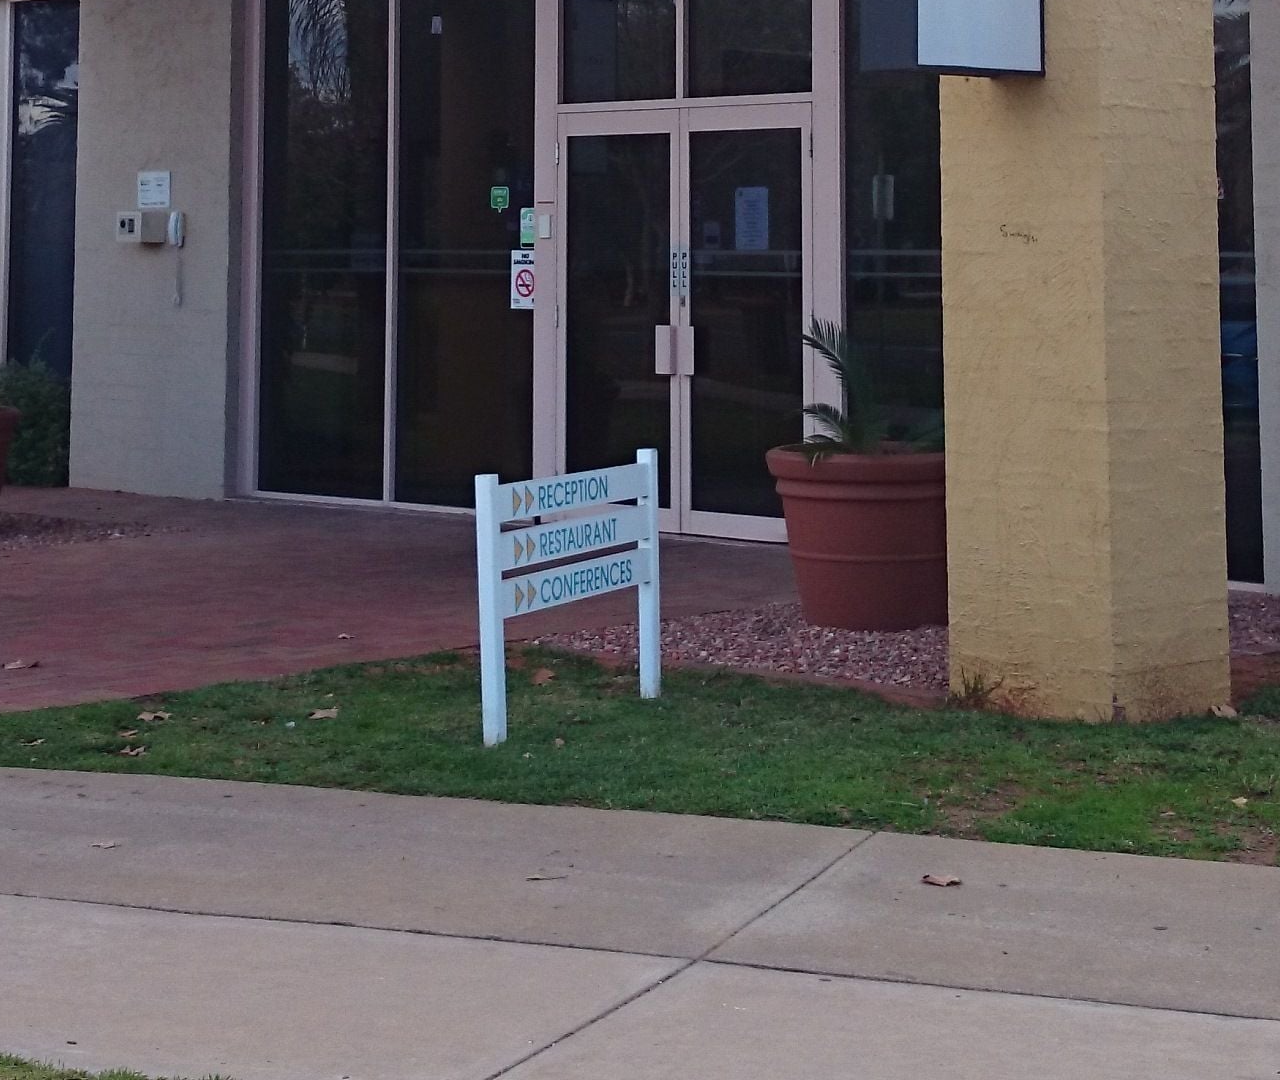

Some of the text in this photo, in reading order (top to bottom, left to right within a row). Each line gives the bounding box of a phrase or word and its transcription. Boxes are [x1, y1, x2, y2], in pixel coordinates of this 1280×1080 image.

[538, 476, 608, 510] RECEPTION
[540, 518, 617, 557] RESTAURANT
[540, 559, 632, 603] CONFERENCES
